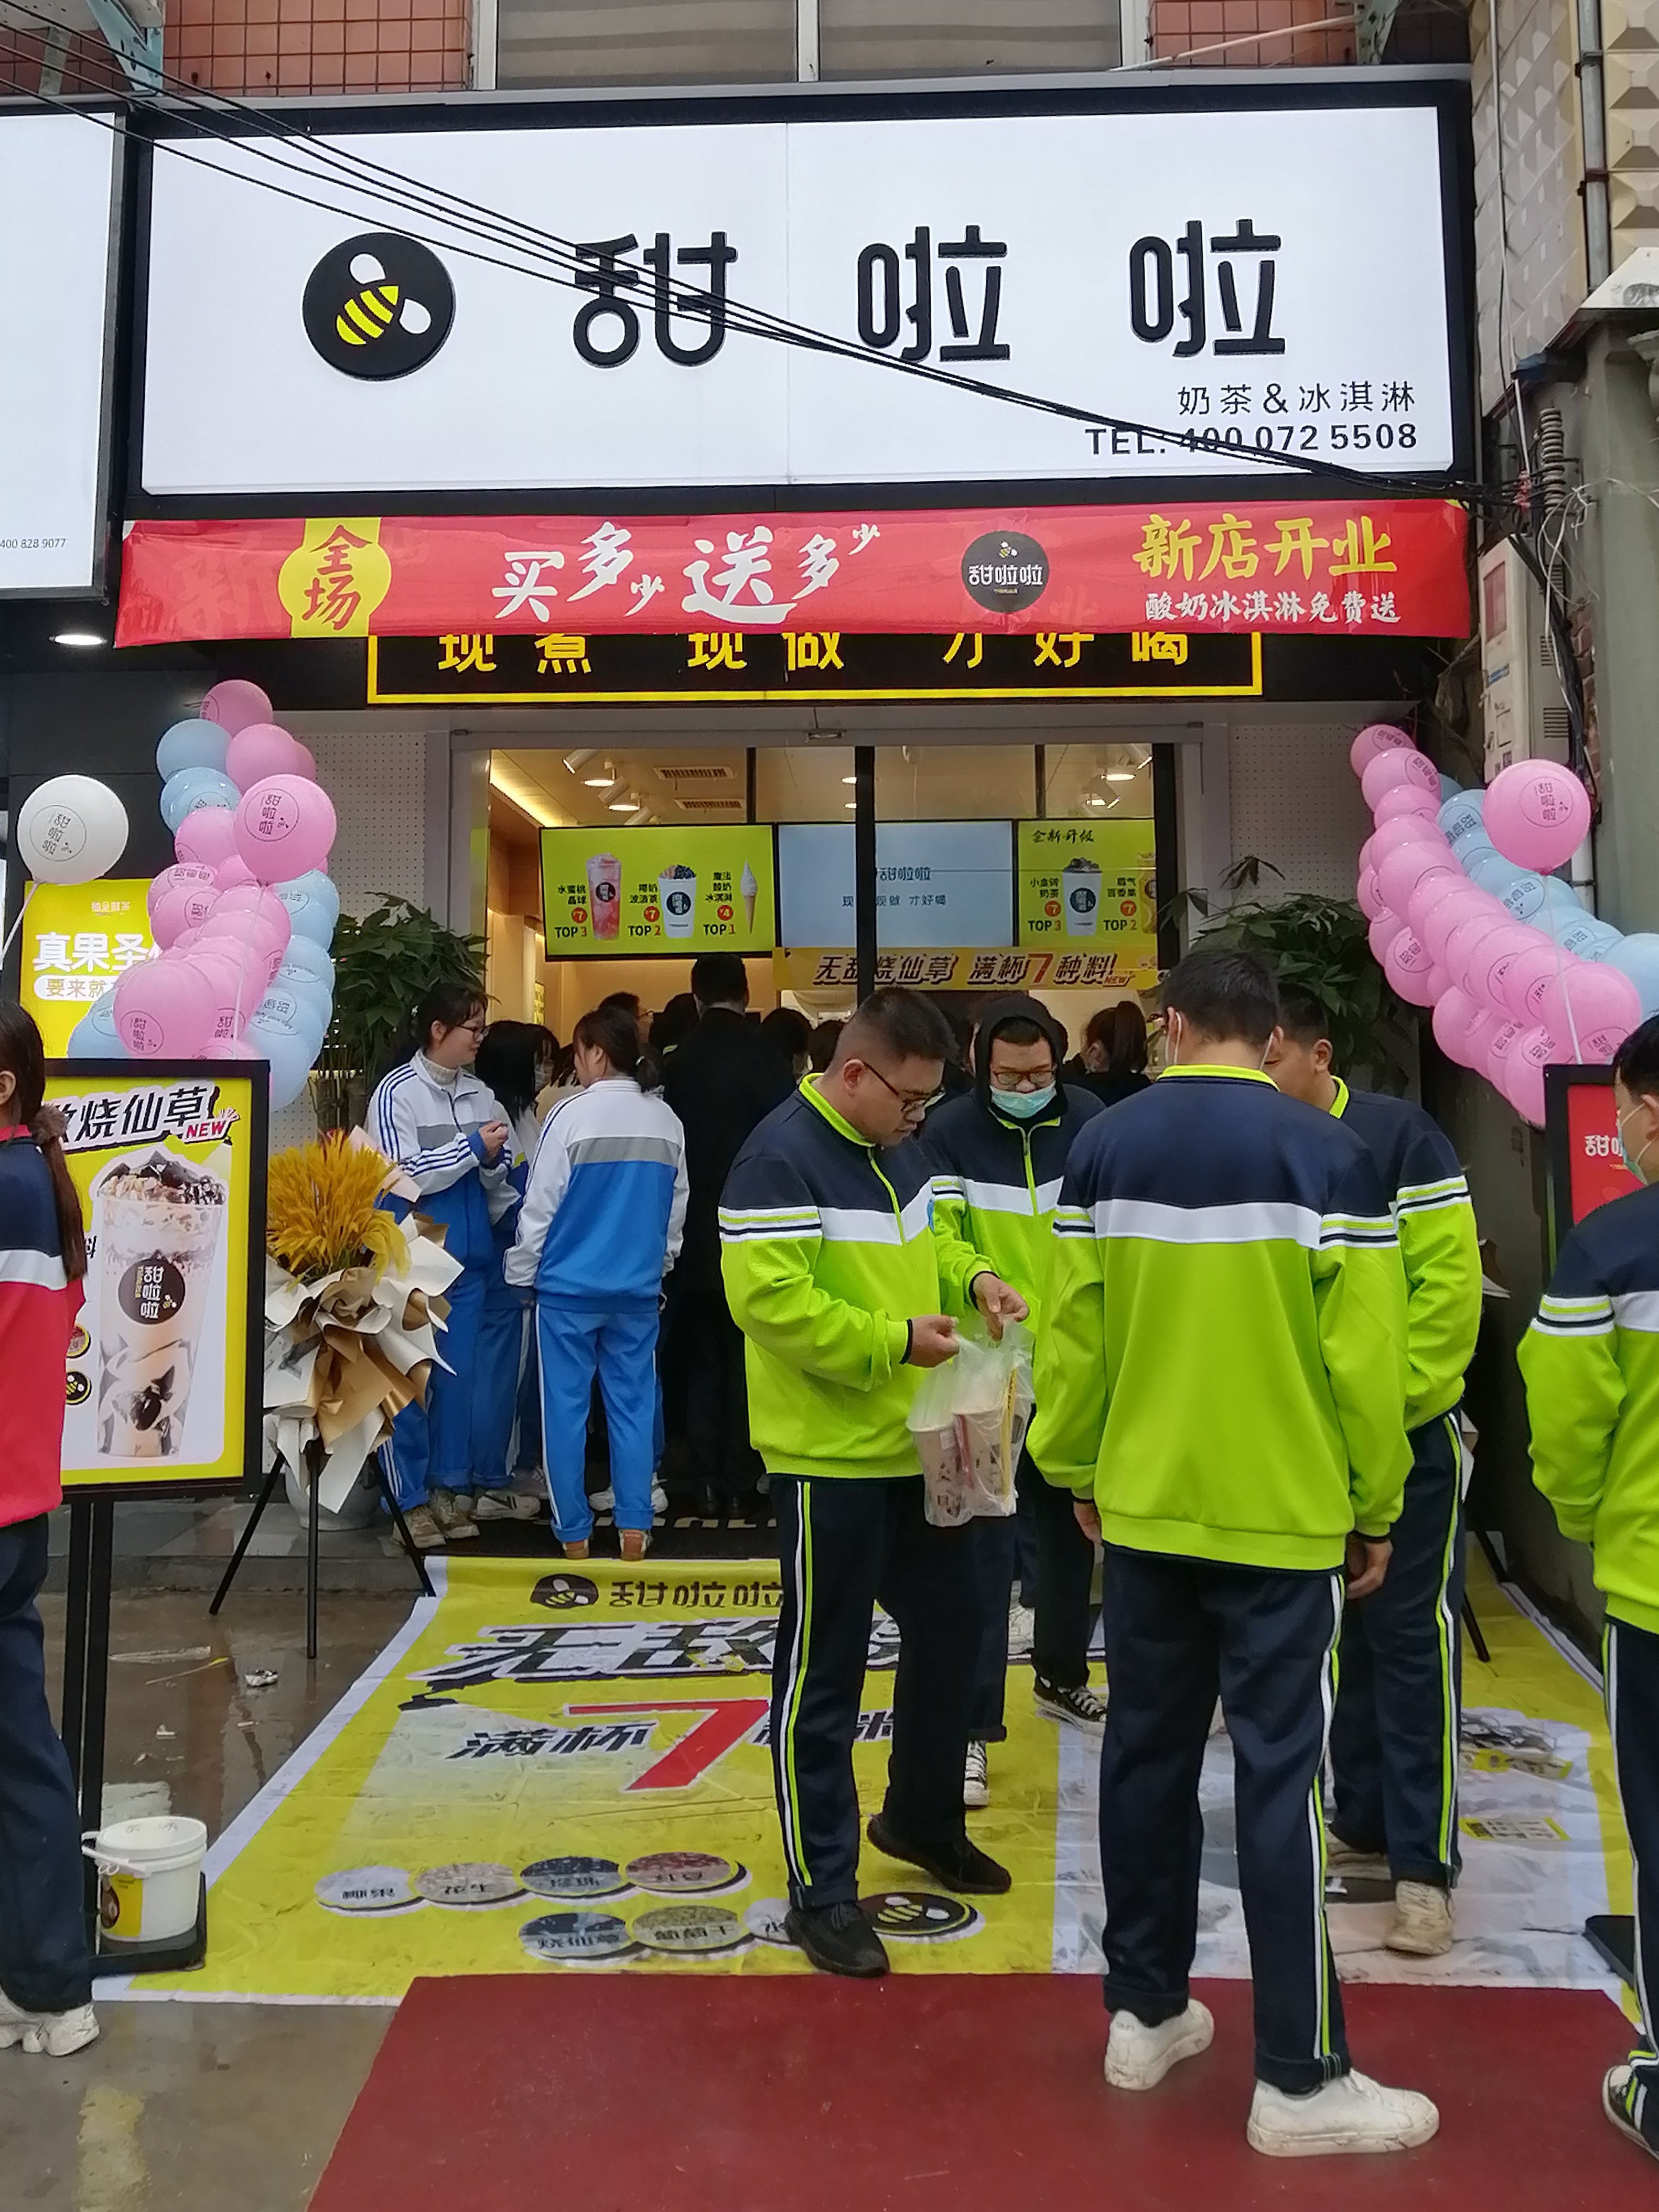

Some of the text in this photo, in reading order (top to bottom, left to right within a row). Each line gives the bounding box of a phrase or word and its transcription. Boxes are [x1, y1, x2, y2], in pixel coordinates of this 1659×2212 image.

[573, 219, 1286, 368] 甜啦啦
[1178, 381, 1415, 415] 奶茶&冰淇淋
[1085, 428, 1165, 455] TEL.
[1255, 425, 1319, 451] 072
[1330, 423, 1417, 450] 5508
[21, 538, 39, 548] 828
[42, 538, 67, 548] 9077
[1133, 514, 1397, 582] 新店开业
[302, 525, 373, 631] 全场
[491, 521, 880, 623] 买多少送多少
[969, 564, 1043, 586] 甜啦啦
[1145, 590, 1401, 625] 酸奶冰淇淋免费送
[555, 926, 587, 938] TOP 3
[628, 925, 661, 936] TOP 2
[703, 924, 735, 935] TOP 1
[1028, 920, 1061, 931] TOP 3
[1103, 920, 1137, 931] TOP 2
[33, 932, 162, 973] 真果圣
[46, 978, 116, 998] 要来就
[187, 1121, 224, 1137] NEW
[140, 1265, 165, 1319] 甜啦啦
[609, 1580, 782, 1608] 甜啦啦
[447, 1699, 774, 1790] 满杯7
